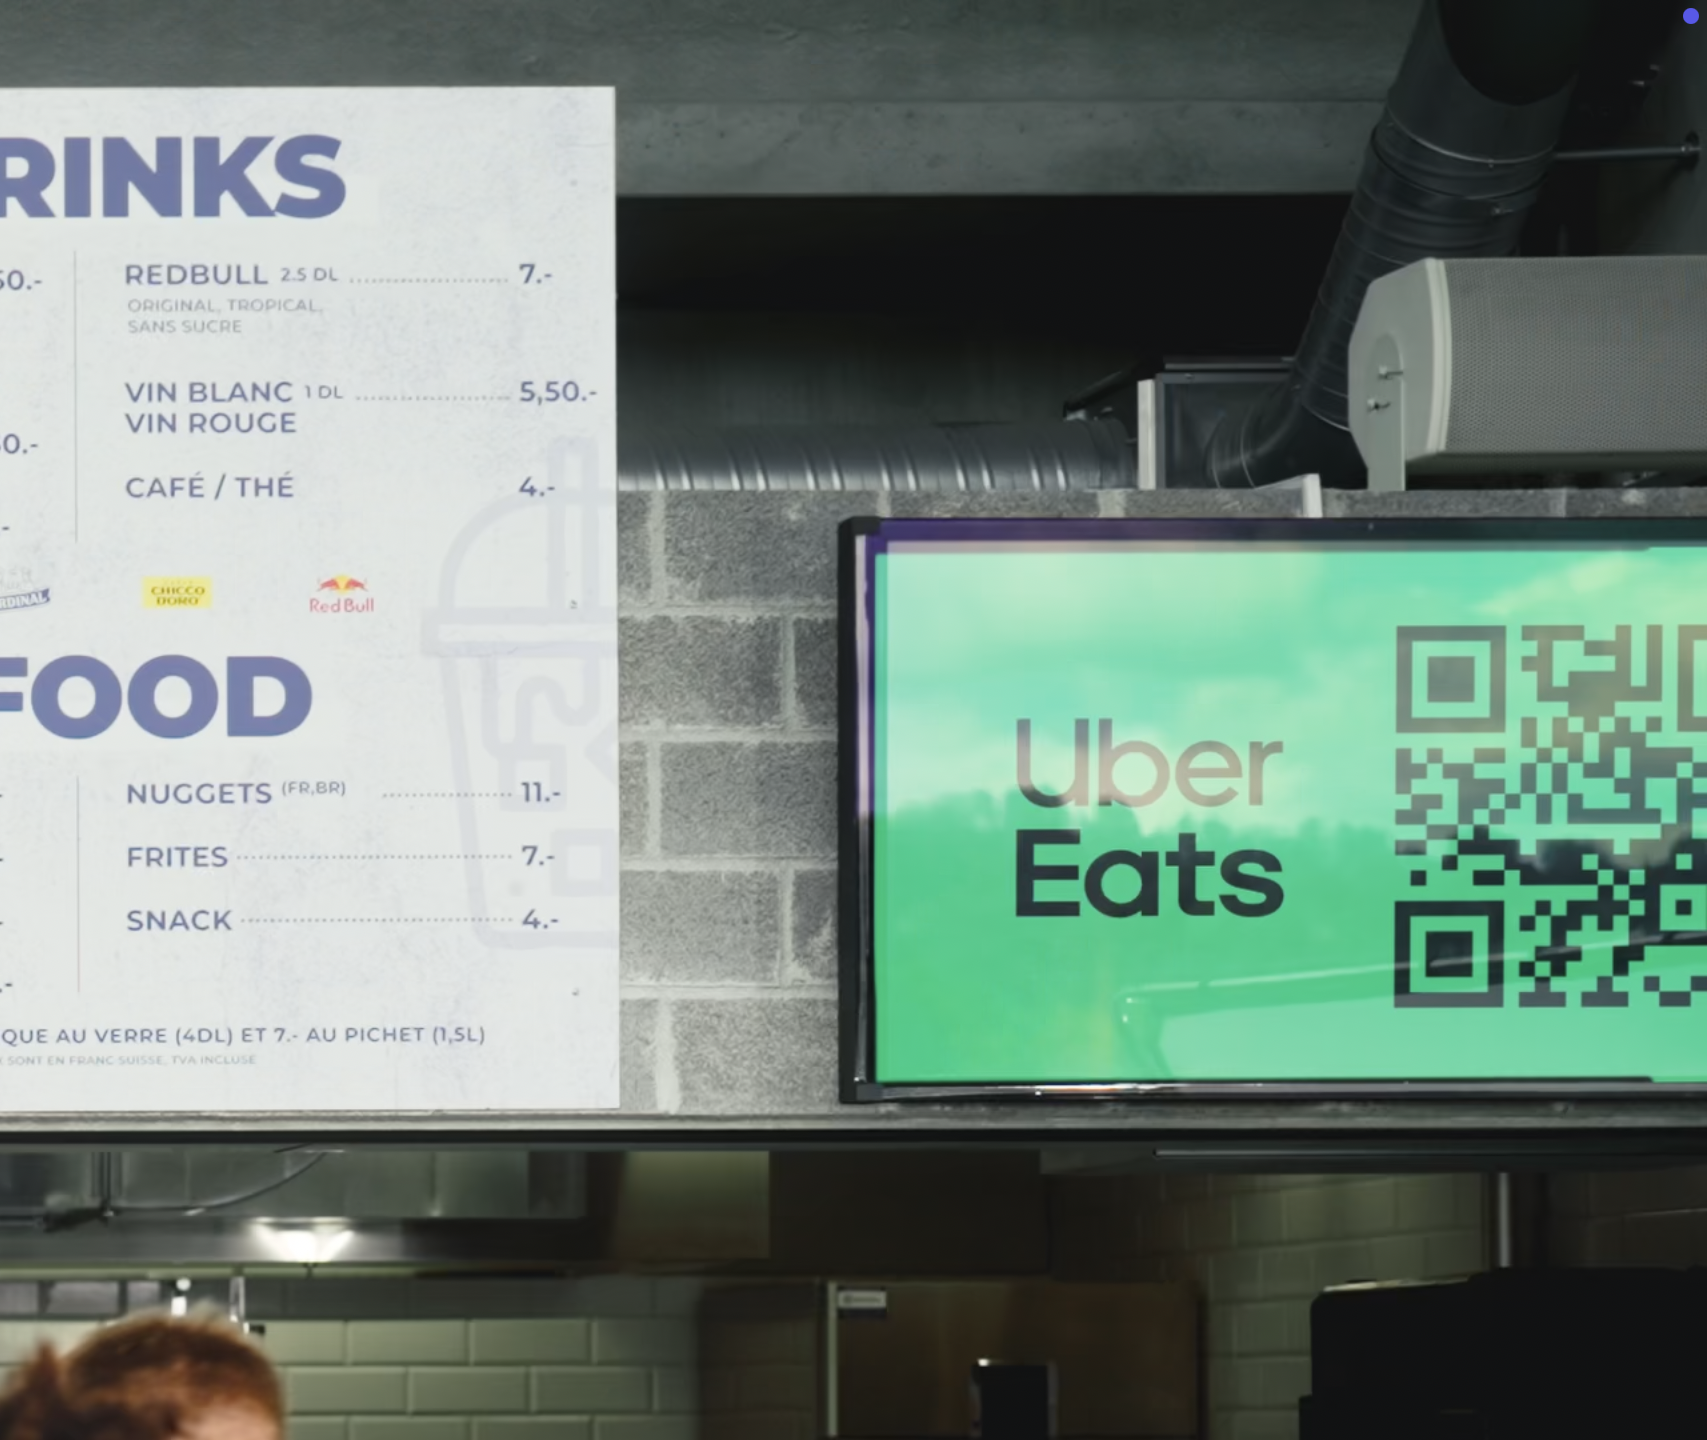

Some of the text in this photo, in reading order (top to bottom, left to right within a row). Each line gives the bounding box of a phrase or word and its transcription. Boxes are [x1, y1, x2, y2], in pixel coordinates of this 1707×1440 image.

[125, 264, 268, 285] REDBULL
[313, 267, 339, 282] DL
[519, 263, 552, 284] 7.-
[128, 320, 242, 334] SANS SUCRE
[124, 380, 596, 406] VIN BLANC 1 DL 5,50.-
[125, 412, 296, 433] VIN ROUGE
[125, 471, 555, 500] CAFÉ / THÉ 4.-
[310, 597, 374, 613] Red Bull
[1016, 718, 1284, 808] Uber
[127, 781, 561, 804] NUGGETS (FR,BR) 11.-
[128, 845, 555, 867] FRITES 7.-
[1015, 828, 1284, 918] Eats
[127, 909, 558, 931] SNACK 4.-
[56, 1029, 86, 1044] AU
[94, 1028, 167, 1043] VERRE
[176, 1028, 232, 1046] (4DL)
[242, 1028, 267, 1043] ET
[273, 1027, 298, 1042] 7.-
[306, 1028, 336, 1042] AU
[345, 1027, 425, 1042] PICHET
[432, 1026, 485, 1046] (1,5L)
